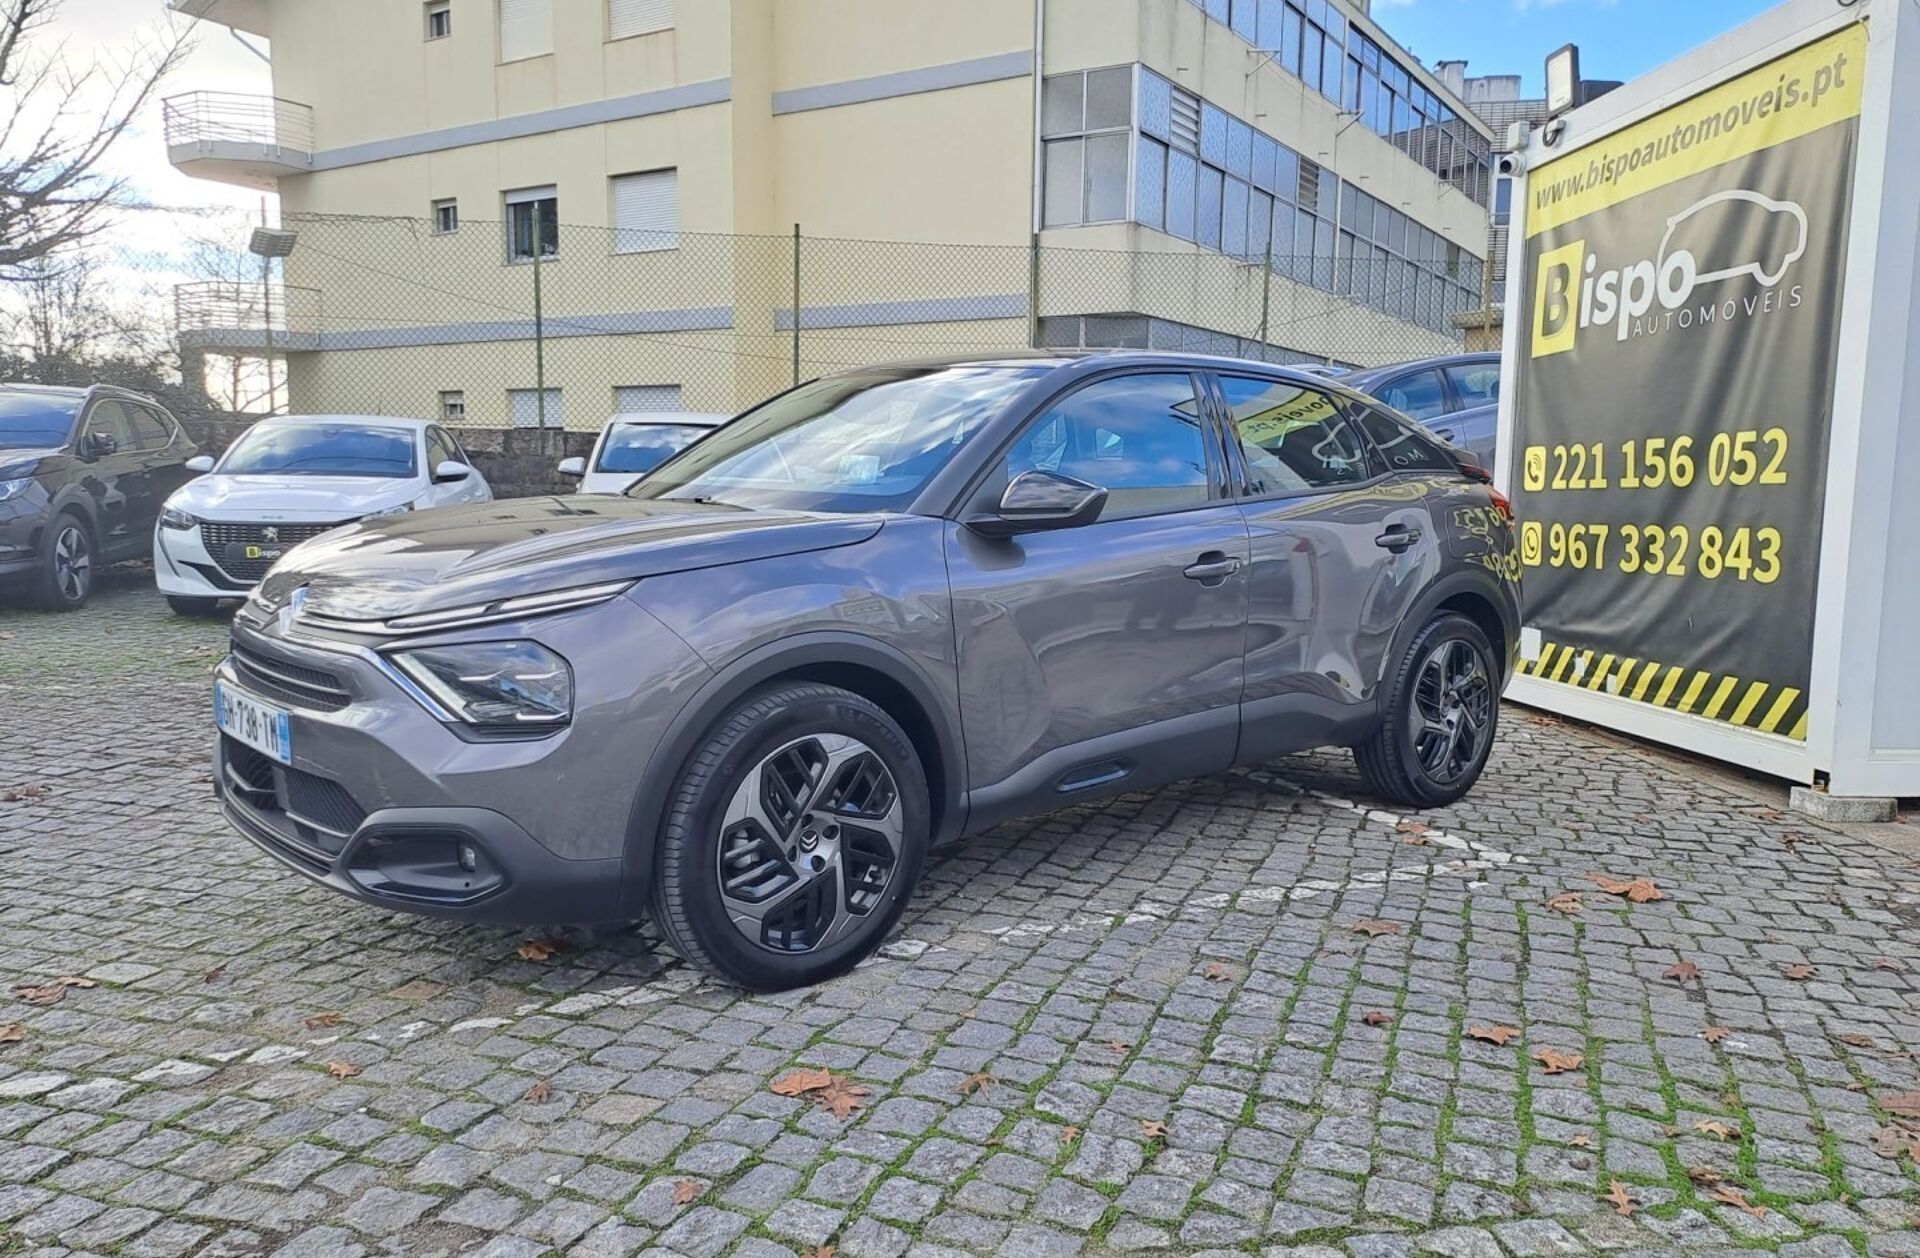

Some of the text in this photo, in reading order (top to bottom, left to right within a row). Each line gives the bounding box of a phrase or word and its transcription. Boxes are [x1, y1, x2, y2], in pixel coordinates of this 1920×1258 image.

[1536, 52, 1847, 211] www.bispoautomoveis.pt
[1540, 249, 1697, 342] Bispo
[1632, 285, 1802, 338] AUTOMÓVEIS
[1551, 427, 1788, 490] 221 156 052
[1549, 522, 1609, 570] 967
[1619, 524, 1689, 576] 332
[1698, 525, 1781, 583] 843
